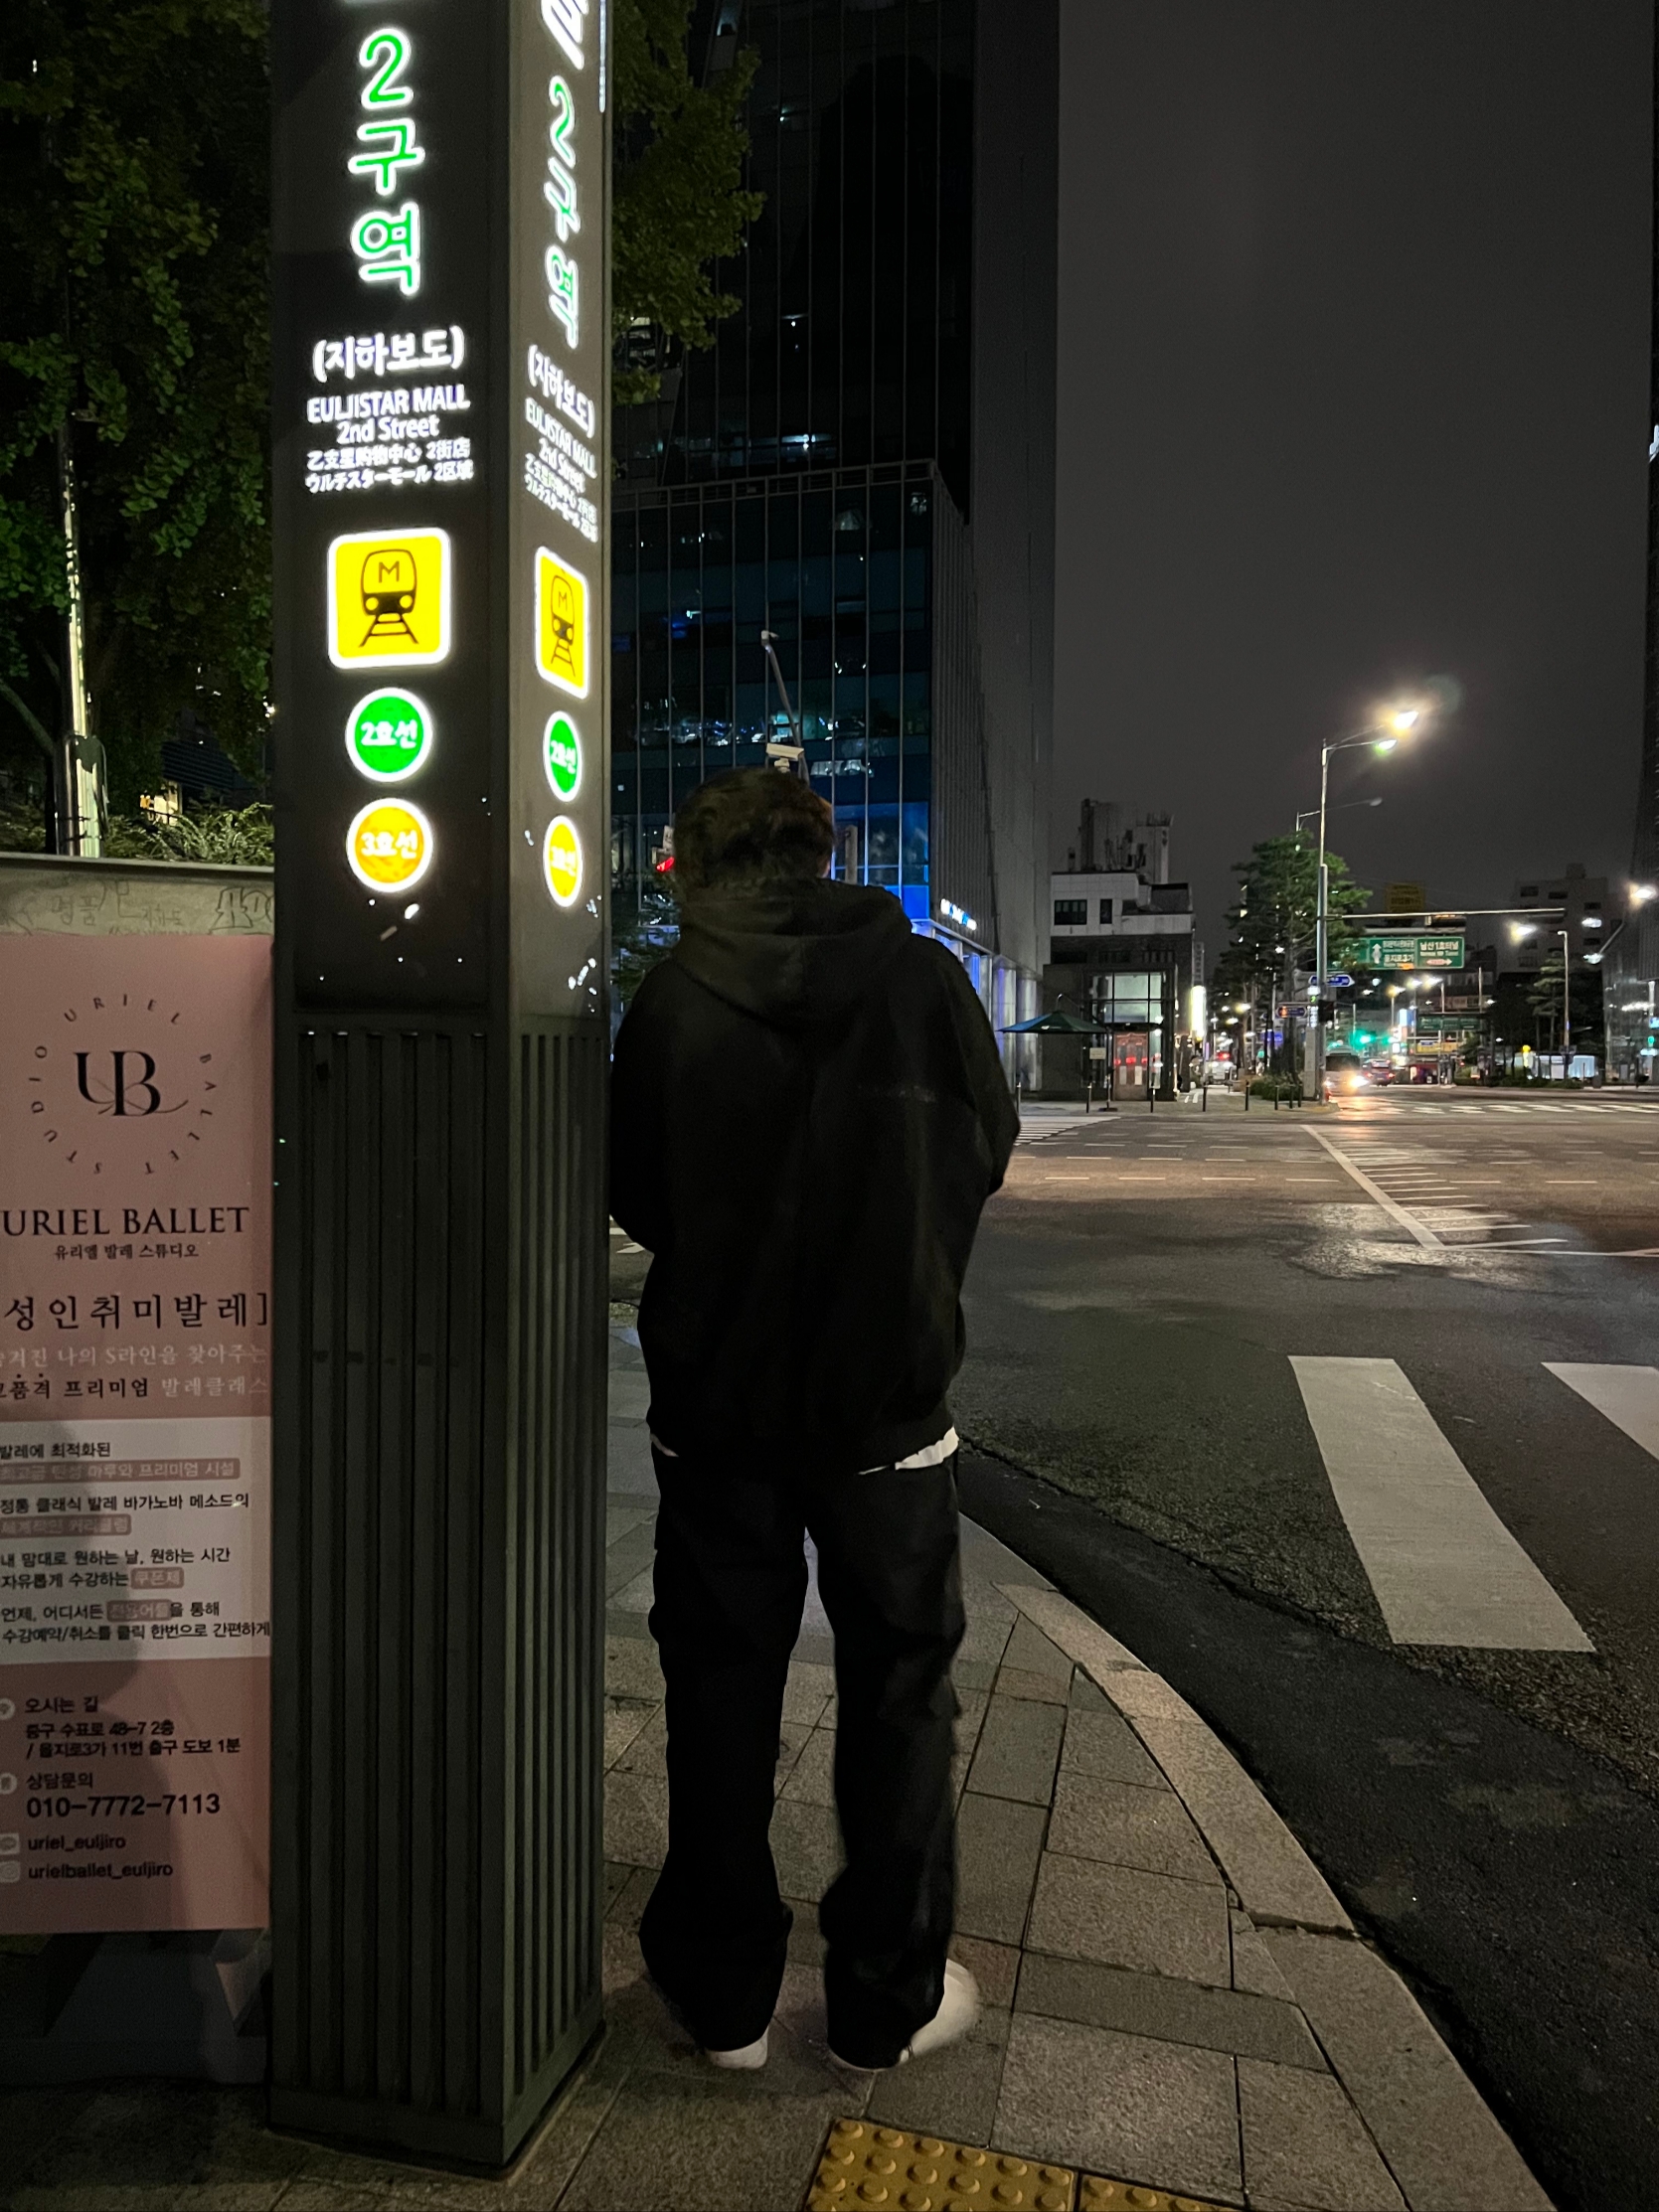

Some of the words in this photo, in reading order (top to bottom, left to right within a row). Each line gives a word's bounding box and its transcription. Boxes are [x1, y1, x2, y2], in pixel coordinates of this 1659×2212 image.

[348, 28, 425, 295] 2구역
[312, 325, 466, 384] (지하보도)
[413, 384, 471, 414] MALL
[528, 344, 595, 439] (지하보도)
[336, 417, 375, 444] 2nd
[378, 413, 440, 441] Street
[571, 436, 597, 479] MALL
[379, 561, 400, 582] M
[361, 719, 417, 749] 2호선
[361, 832, 418, 860] 3호선
[1, 1208, 110, 1236] URIEL
[122, 1207, 249, 1234] BALLET
[55, 1245, 97, 1260] 유리엘
[104, 1244, 133, 1260] 발레
[139, 1244, 199, 1258] 스튜디오
[58, 1346, 97, 1366] 나의
[105, 1344, 179, 1365] S라인을
[188, 1343, 268, 1365] 찾아주는
[64, 1377, 149, 1398] 프리미엄
[161, 1375, 268, 1398] 발레클래스
[52, 1442, 111, 1459] 최적화된
[138, 1462, 200, 1478] 프리미엄
[205, 1461, 236, 1476] 시설
[36, 1497, 82, 1512] 클래식
[87, 1496, 117, 1511] 발레
[124, 1494, 183, 1510] 바가노바
[190, 1493, 249, 1508] 메소드의
[1, 1553, 15, 1568] 내
[22, 1552, 68, 1567] 맘대로
[75, 1550, 119, 1566] 원하는
[151, 1548, 195, 1564] 원하는
[201, 1547, 231, 1562] 시간
[1, 1573, 63, 1589] 자유롭게
[69, 1571, 129, 1587] 수강하는
[43, 1604, 104, 1621] 어디서든
[190, 1601, 220, 1618] 통해
[117, 1624, 145, 1641] 클릭
[151, 1623, 208, 1640] 한번으로
[213, 1621, 270, 1638] 간편하게
[25, 1697, 75, 1714] 오시는
[83, 1696, 98, 1713] 길
[61, 1722, 104, 1738] 수표로
[112, 1740, 143, 1757] 11번
[149, 1739, 178, 1756] 출구
[182, 1739, 213, 1754] 도보
[219, 1737, 242, 1754] 1분
[26, 1772, 93, 1790] 상담문의
[27, 1793, 221, 1818] 010-7772-7113
[28, 1833, 126, 1852] uriel_euljiro
[28, 1861, 174, 1880] urielballet_euljiro
